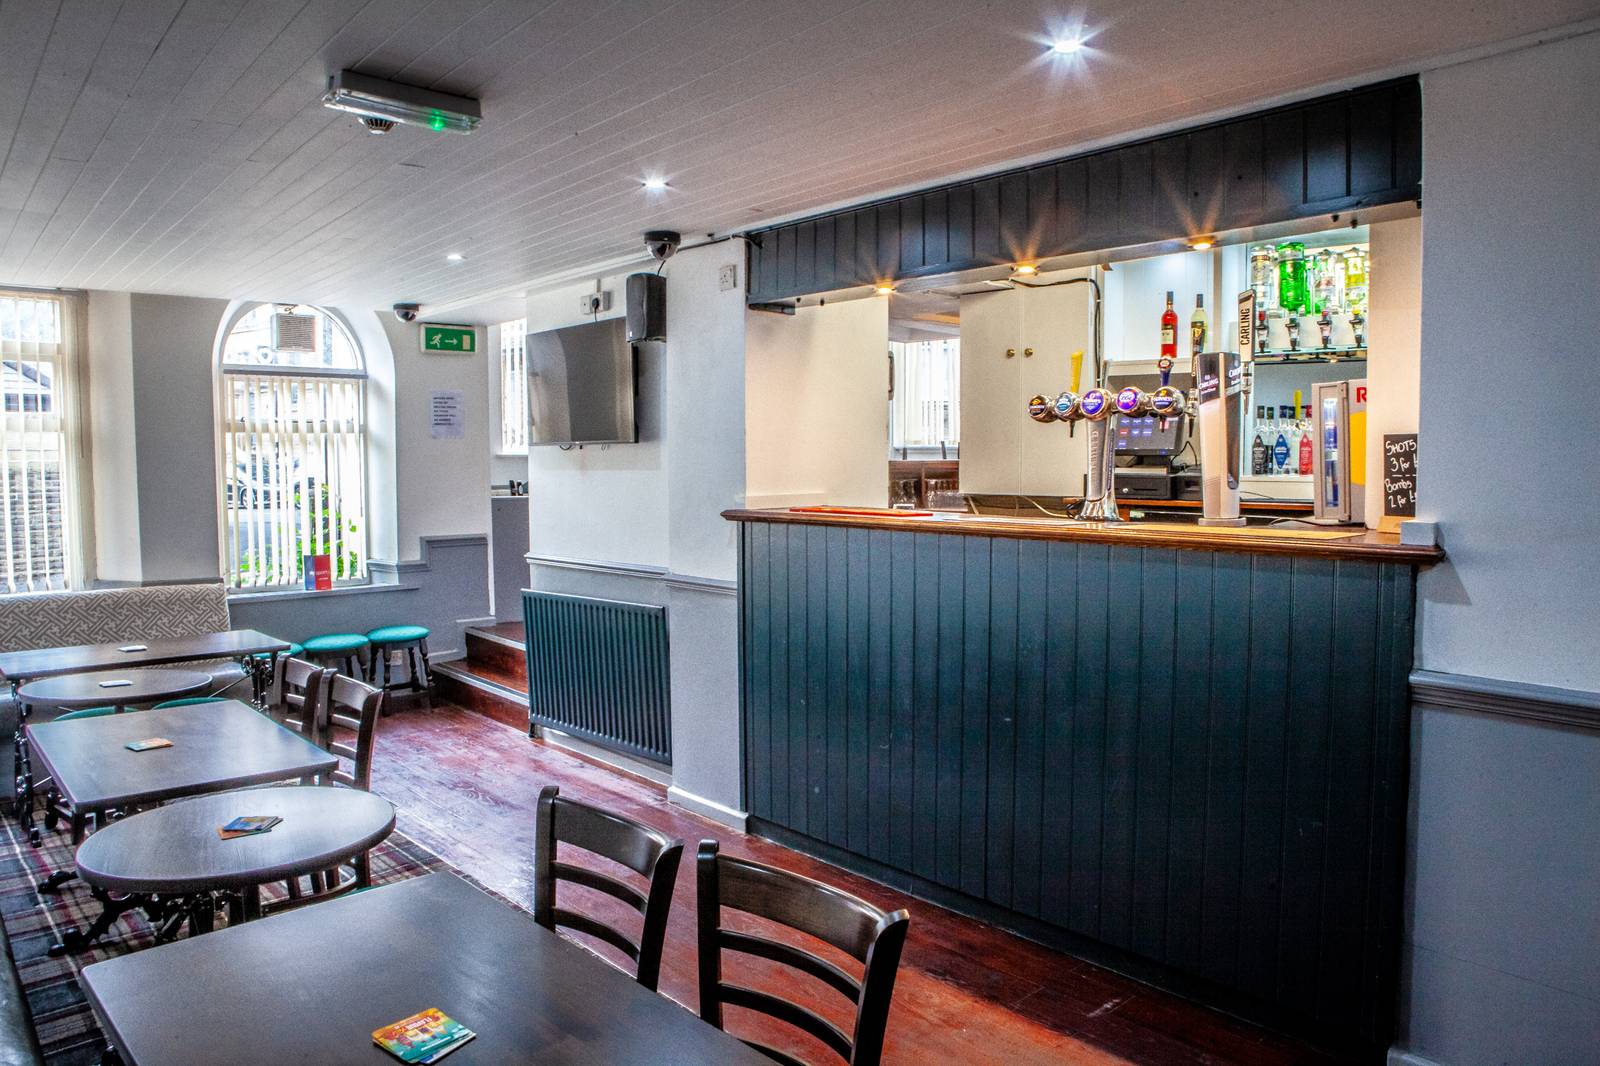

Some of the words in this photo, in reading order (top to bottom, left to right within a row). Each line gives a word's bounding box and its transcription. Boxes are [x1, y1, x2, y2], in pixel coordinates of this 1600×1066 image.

[1240, 308, 1251, 346] CARLING
[1385, 439, 1417, 456] SHOTS
[1390, 457, 1399, 472] 3
[1399, 457, 1411, 472] for
[1384, 478, 1413, 493] Bombs
[1388, 495, 1397, 508] 2
[1397, 494, 1407, 508] for
